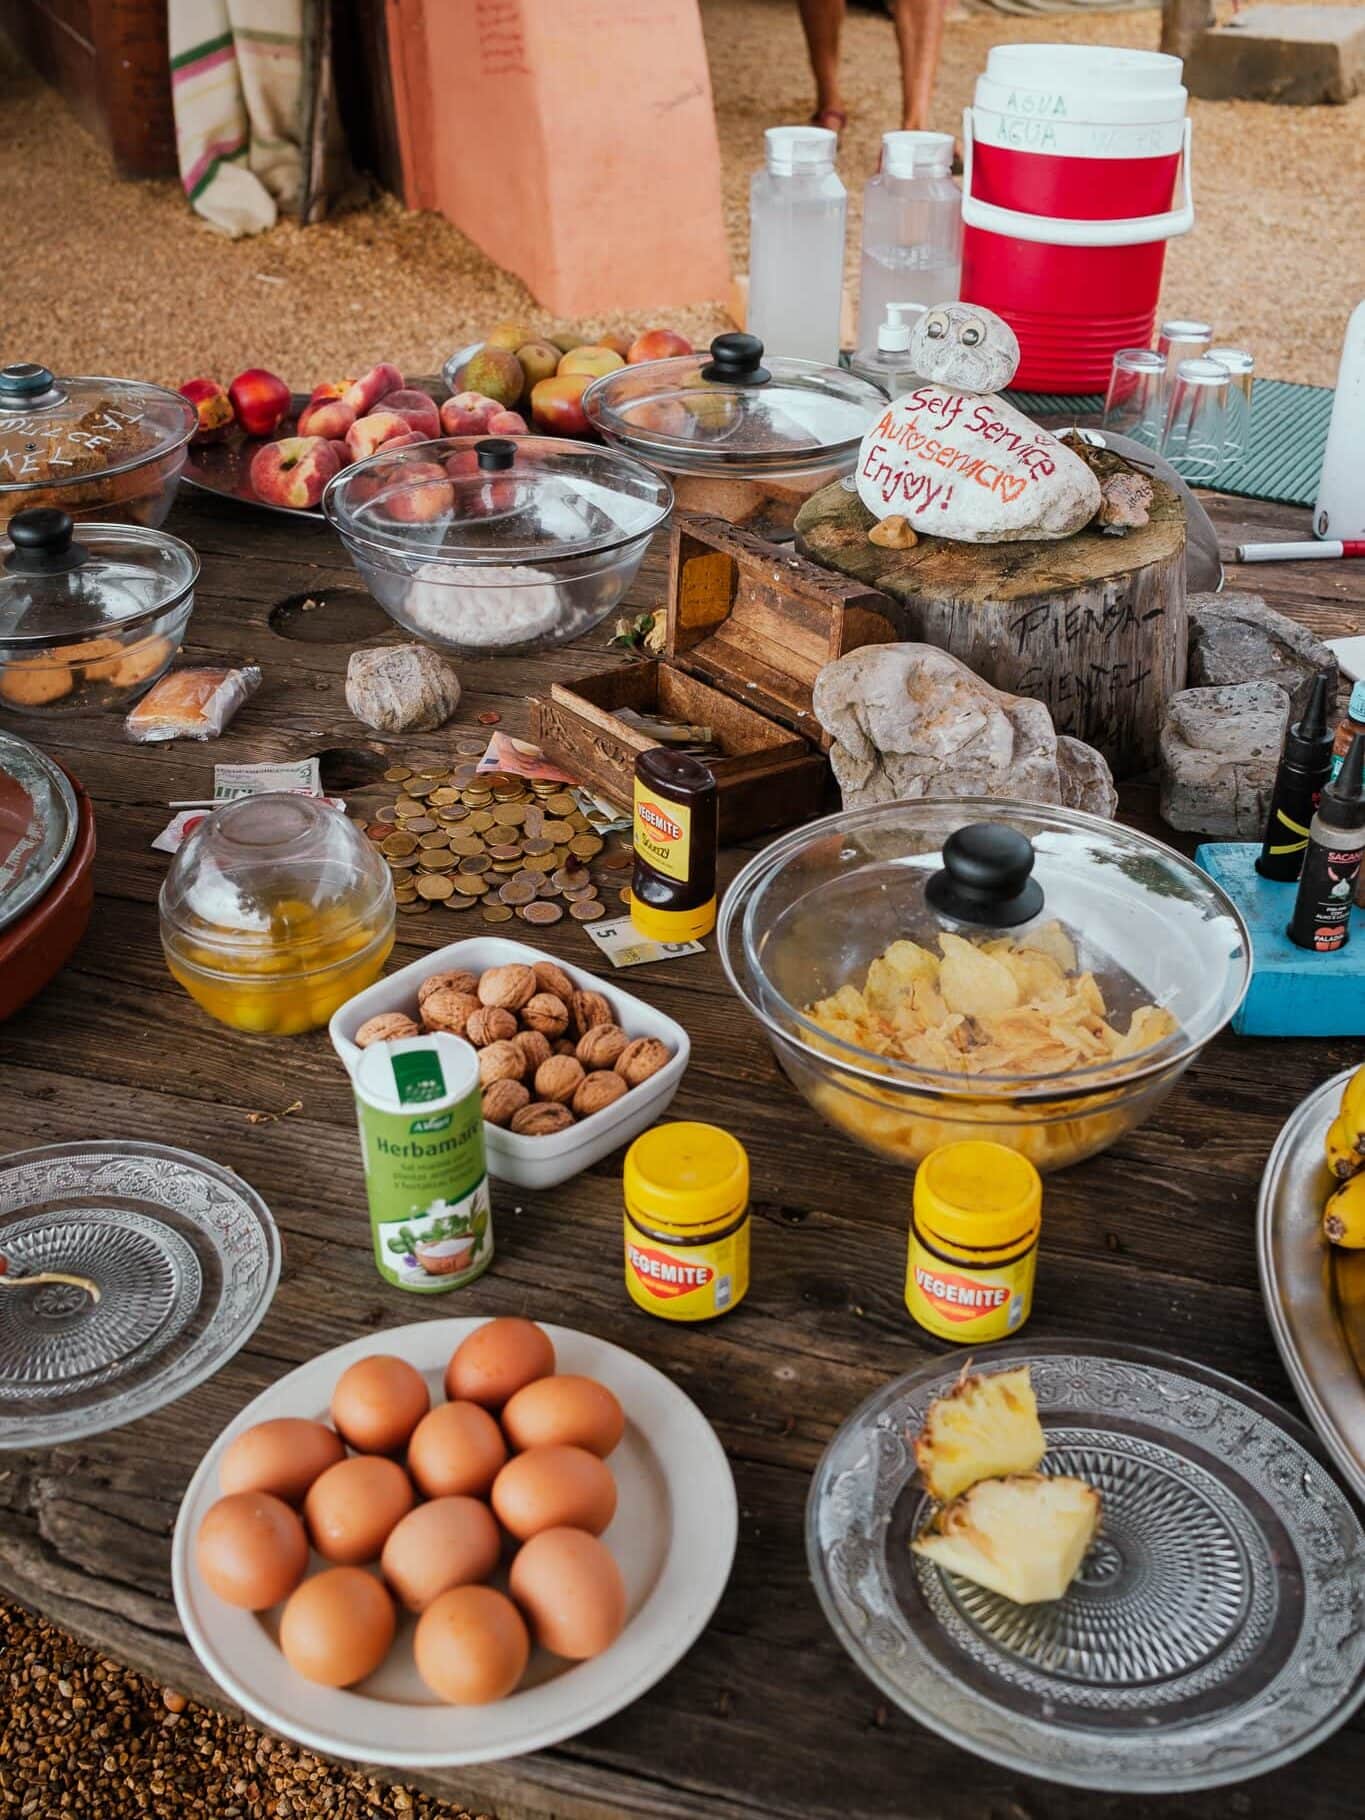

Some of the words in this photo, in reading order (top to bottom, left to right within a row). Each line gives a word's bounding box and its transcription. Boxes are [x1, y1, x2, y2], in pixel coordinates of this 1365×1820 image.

[905, 388, 964, 431] Self
[964, 405, 1057, 482] Service
[915, 1266, 1006, 1308] VEGEMITE
